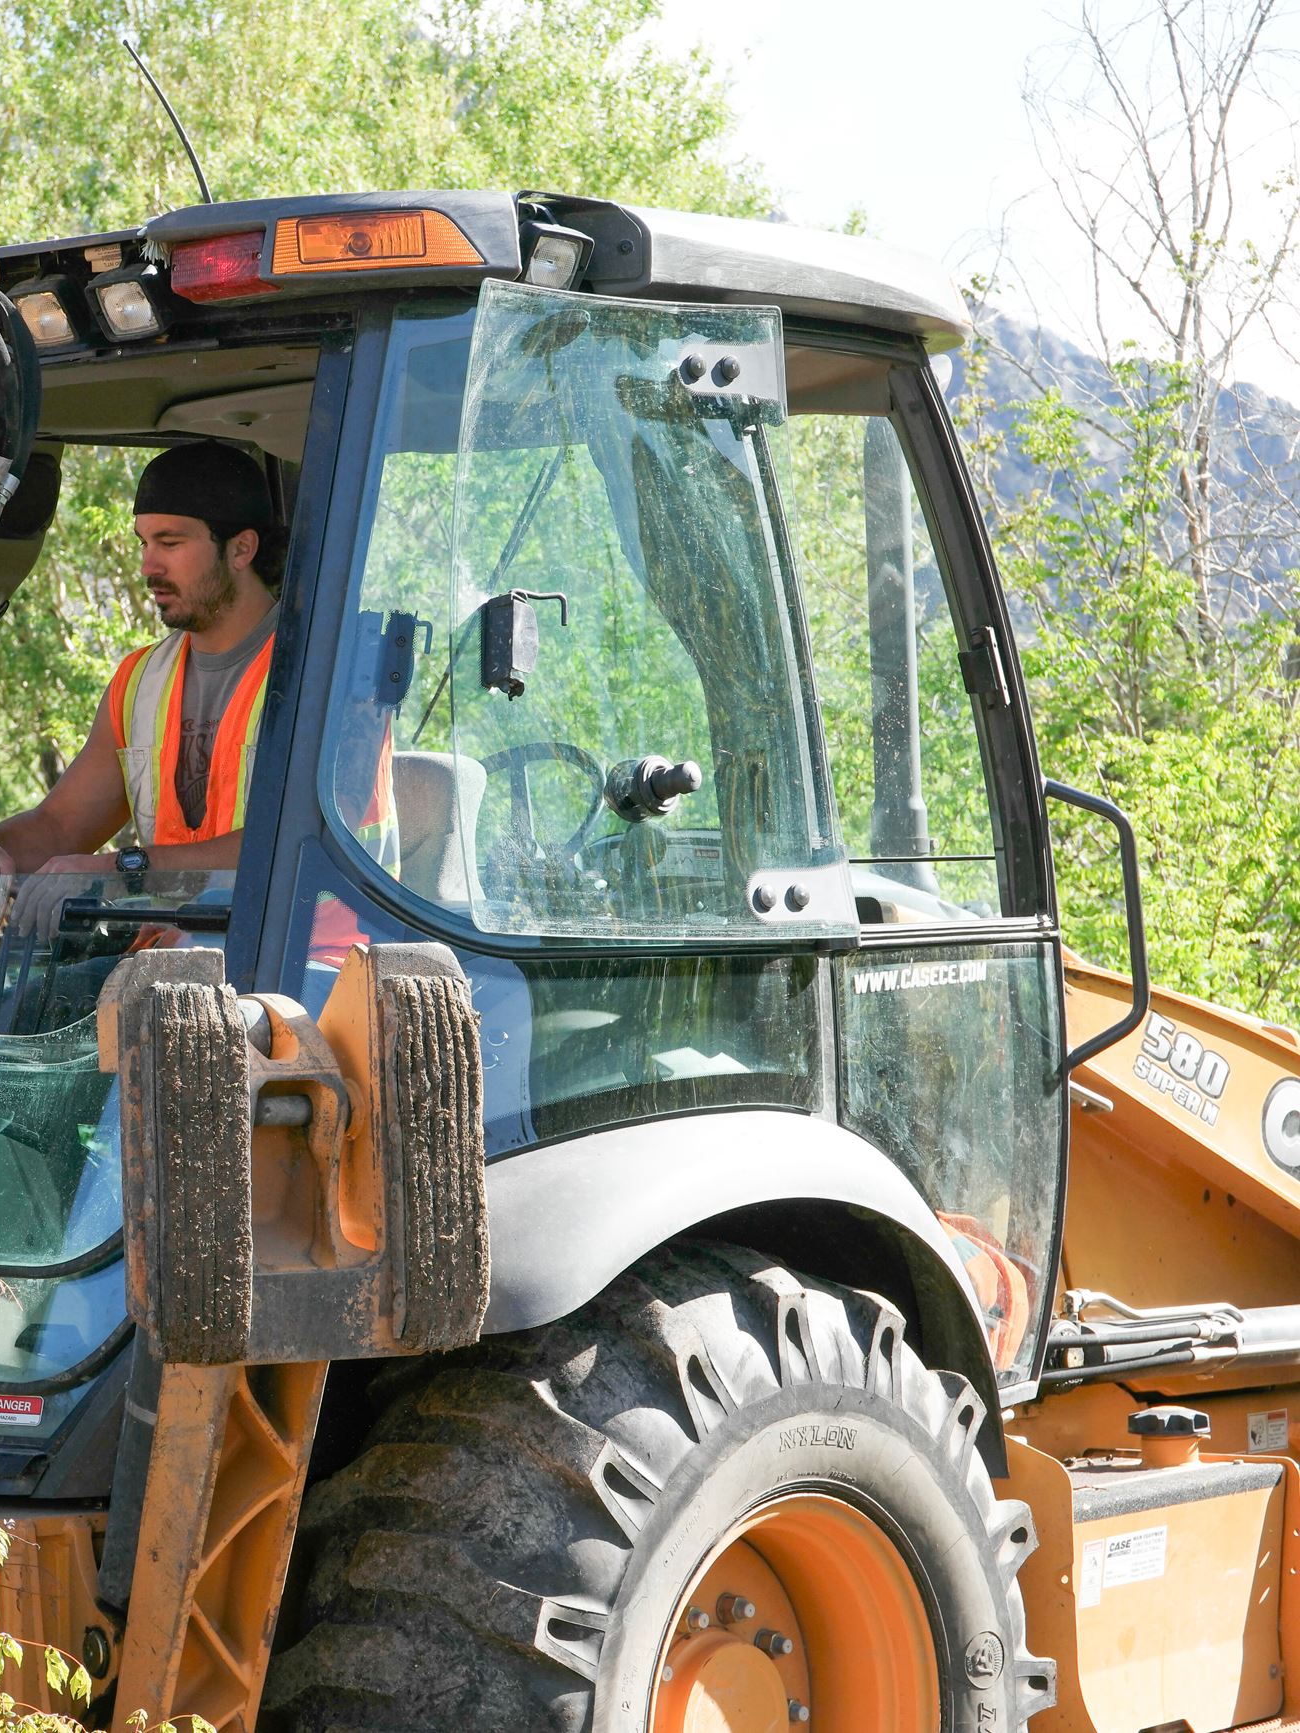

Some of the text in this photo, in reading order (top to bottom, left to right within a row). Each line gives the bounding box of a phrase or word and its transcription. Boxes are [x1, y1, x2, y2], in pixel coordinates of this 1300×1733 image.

[854, 961, 987, 994] WWW.CASECE.COM
[1141, 1010, 1231, 1099] 580
[1133, 1054, 1203, 1115] SUPER
[779, 1425, 858, 1452] NYLON
[1109, 1539, 1131, 1552] CASE
